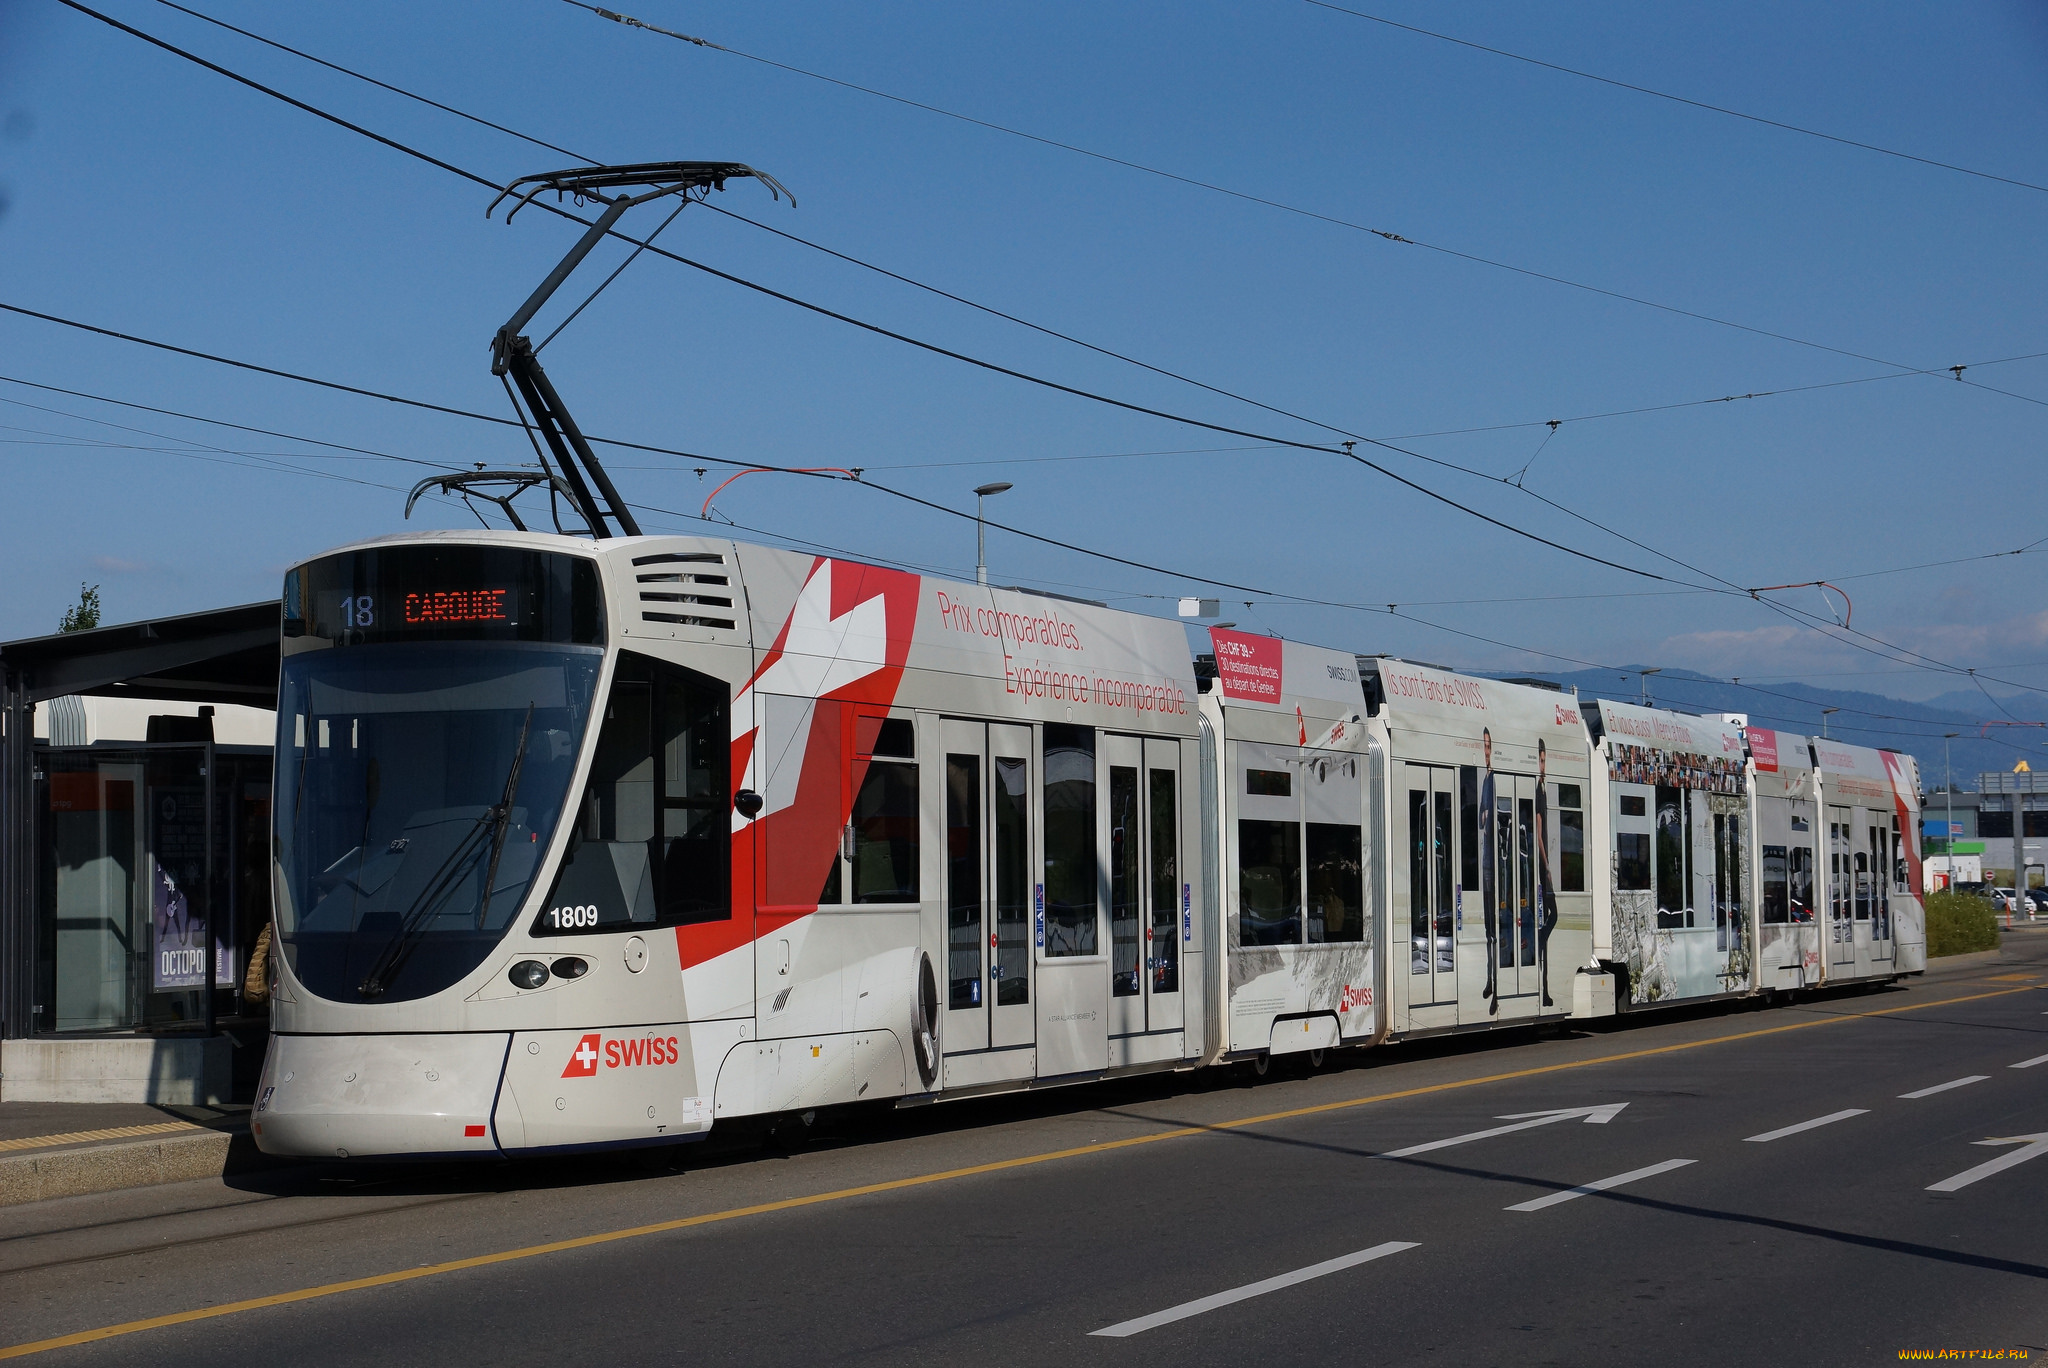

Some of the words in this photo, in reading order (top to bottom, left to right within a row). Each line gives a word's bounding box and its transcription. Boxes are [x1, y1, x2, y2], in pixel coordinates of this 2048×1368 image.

[339, 595, 374, 627] 18
[405, 589, 506, 622] CAROUGE
[936, 591, 976, 634] Prix
[977, 609, 1084, 651] comparables.
[1216, 639, 1229, 655] Dès
[1227, 641, 1240, 656] CHF
[1220, 656, 1230, 671] 30
[1229, 658, 1260, 676] destinations
[1259, 663, 1279, 679] directes
[1004, 655, 1089, 704] Expérience
[1092, 669, 1189, 718] incomparable.
[1249, 678, 1257, 693] de
[1384, 665, 1399, 695] Ils
[1399, 673, 1423, 699] sont
[1420, 671, 1443, 703] fans
[1443, 676, 1456, 704] de
[1454, 678, 1488, 710] SWISS.
[1560, 707, 1578, 725] SWISS
[1606, 708, 1618, 733] Et
[1616, 716, 1635, 736] vous
[550, 904, 598, 929] 1809
[1350, 987, 1373, 1007] SWISS
[604, 1036, 679, 1069] SWISS
